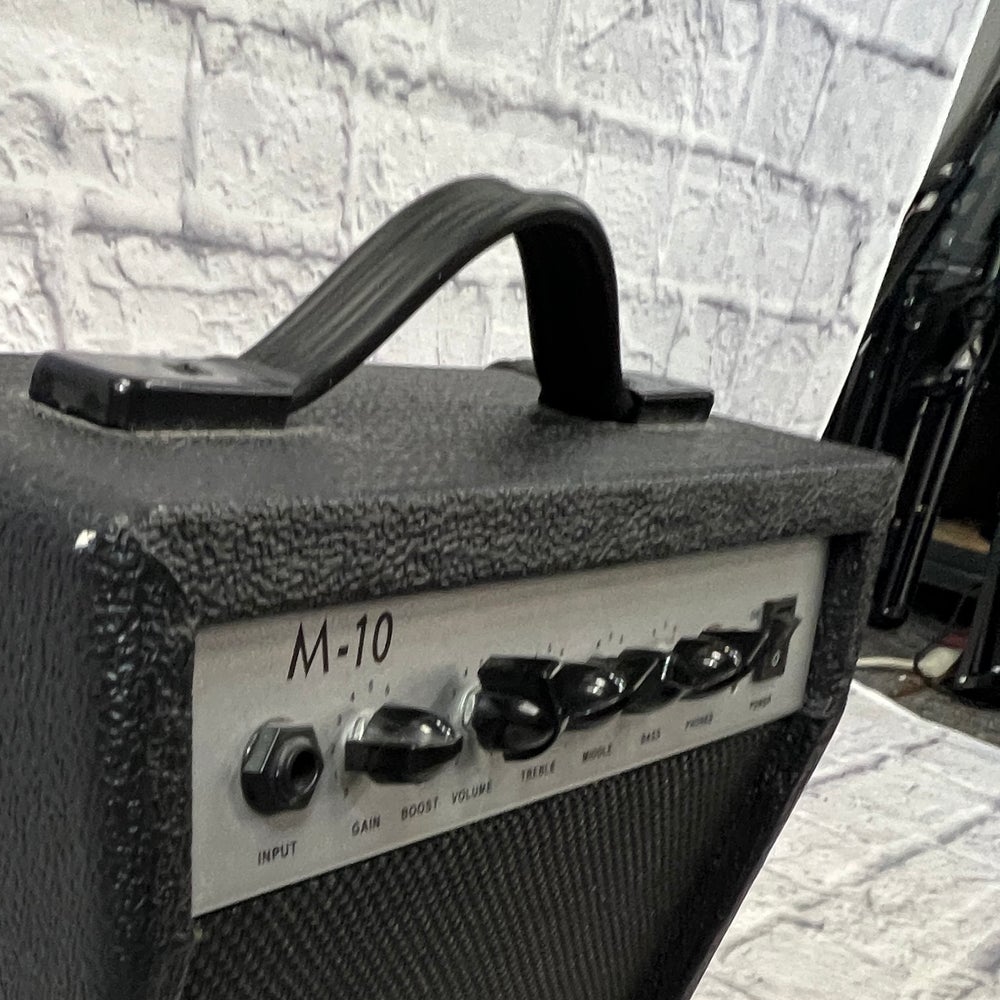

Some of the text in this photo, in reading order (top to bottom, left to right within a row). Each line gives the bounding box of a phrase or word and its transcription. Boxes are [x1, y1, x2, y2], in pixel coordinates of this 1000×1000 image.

[287, 611, 393, 680] M-10
[521, 760, 555, 782] TREBLE
[451, 779, 492, 805] VOLUME
[401, 796, 438, 821] BOOST
[352, 815, 380, 836] GAIN
[257, 841, 297, 866] INPUT
